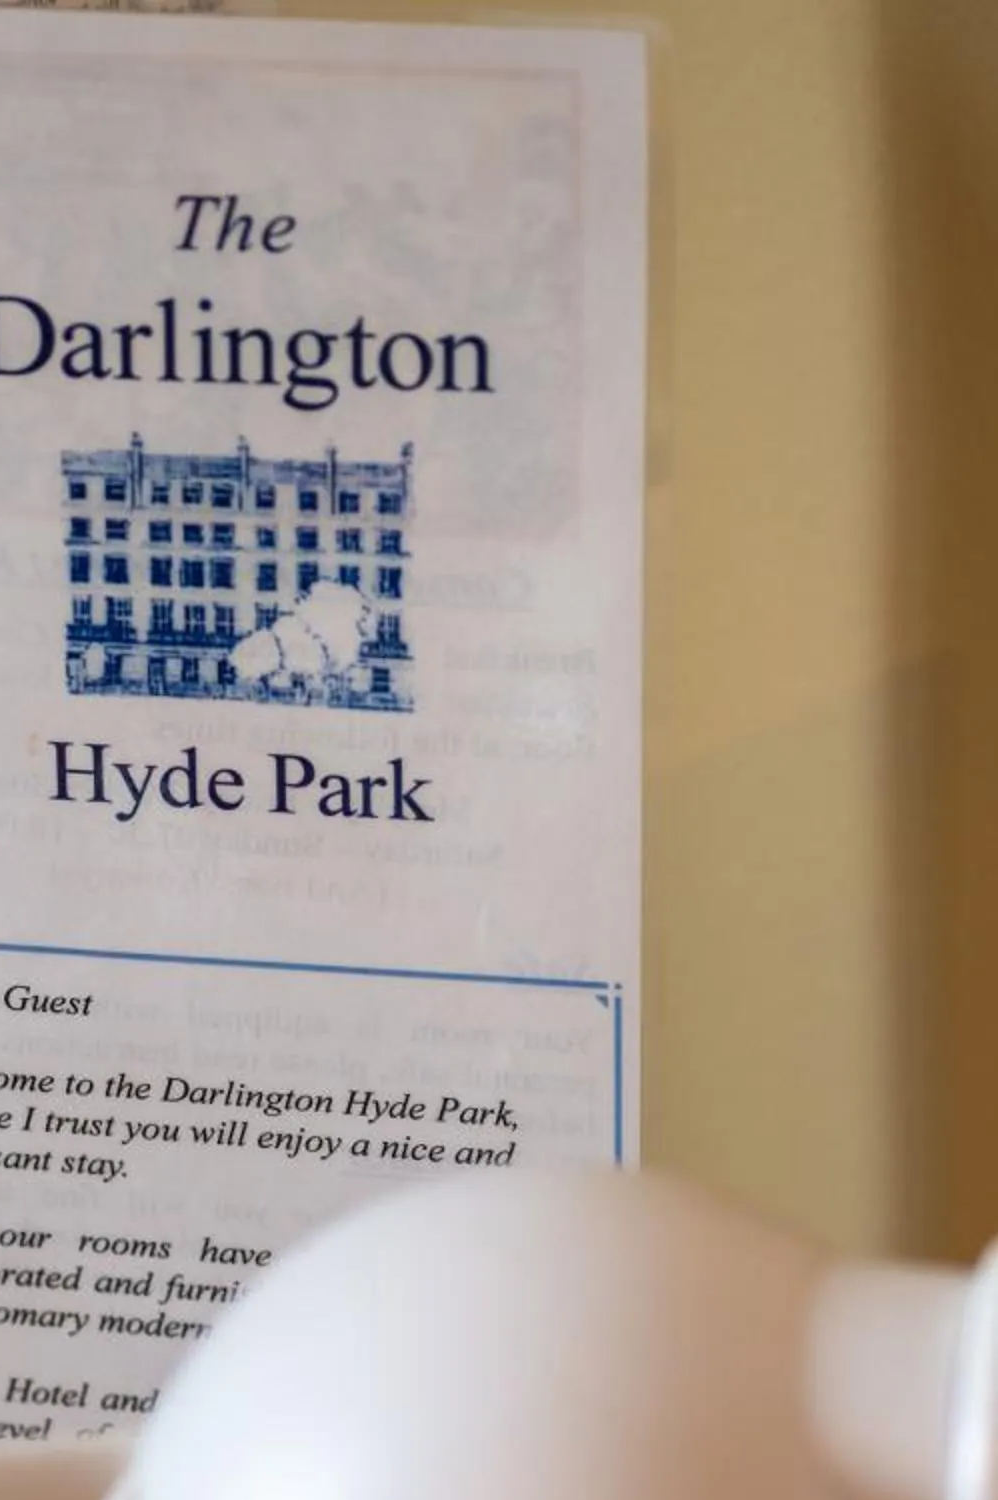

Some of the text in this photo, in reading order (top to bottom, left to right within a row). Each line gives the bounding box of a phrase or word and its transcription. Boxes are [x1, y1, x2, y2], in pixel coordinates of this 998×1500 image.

[172, 194, 297, 253] The
[47, 740, 245, 822] Hyde
[267, 753, 436, 821] Park
[3, 985, 93, 1016] Guest
[65, 1074, 94, 1096] to
[105, 1073, 151, 1100] the
[162, 1076, 334, 1117] Darlington
[342, 1089, 427, 1124] Hyde
[436, 1096, 520, 1132] Park,
[21, 1106, 38, 1133] I
[45, 1113, 115, 1138] trust
[121, 1122, 180, 1146] you
[189, 1121, 249, 1147] will
[257, 1127, 342, 1161] enjoy
[350, 1138, 370, 1158] a
[380, 1136, 445, 1163] nice
[454, 1142, 517, 1168] and
[61, 1154, 129, 1183] stay.
[78, 1235, 172, 1260] rooms
[199, 1236, 273, 1267] have
[93, 1271, 154, 1297] and
[159, 1274, 242, 1306] furni
[5, 1376, 90, 1408] Hotel
[100, 1389, 161, 1414] and
